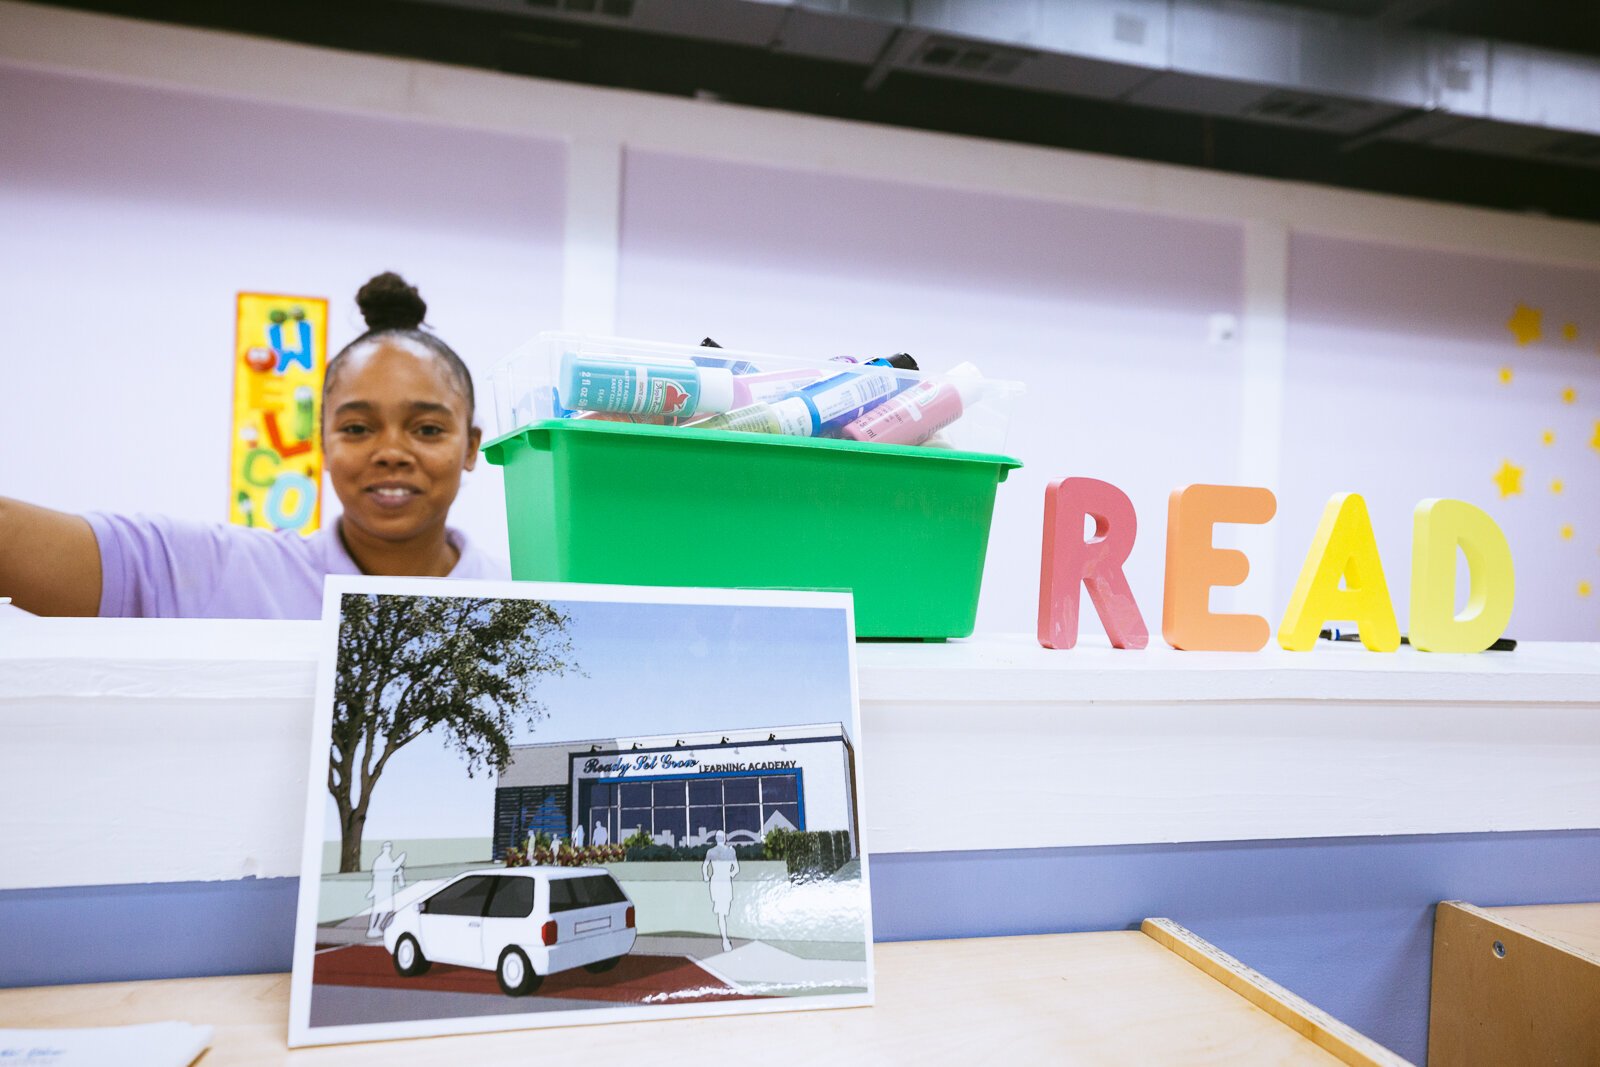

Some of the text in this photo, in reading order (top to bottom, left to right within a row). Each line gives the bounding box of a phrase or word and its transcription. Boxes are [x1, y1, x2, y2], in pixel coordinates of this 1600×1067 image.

[243, 320, 317, 531] WELCO
[580, 387, 589, 398] oz
[1037, 476, 1516, 653] READ
[583, 754, 797, 777] Ready Set Grow LEARNING ACADEMY
